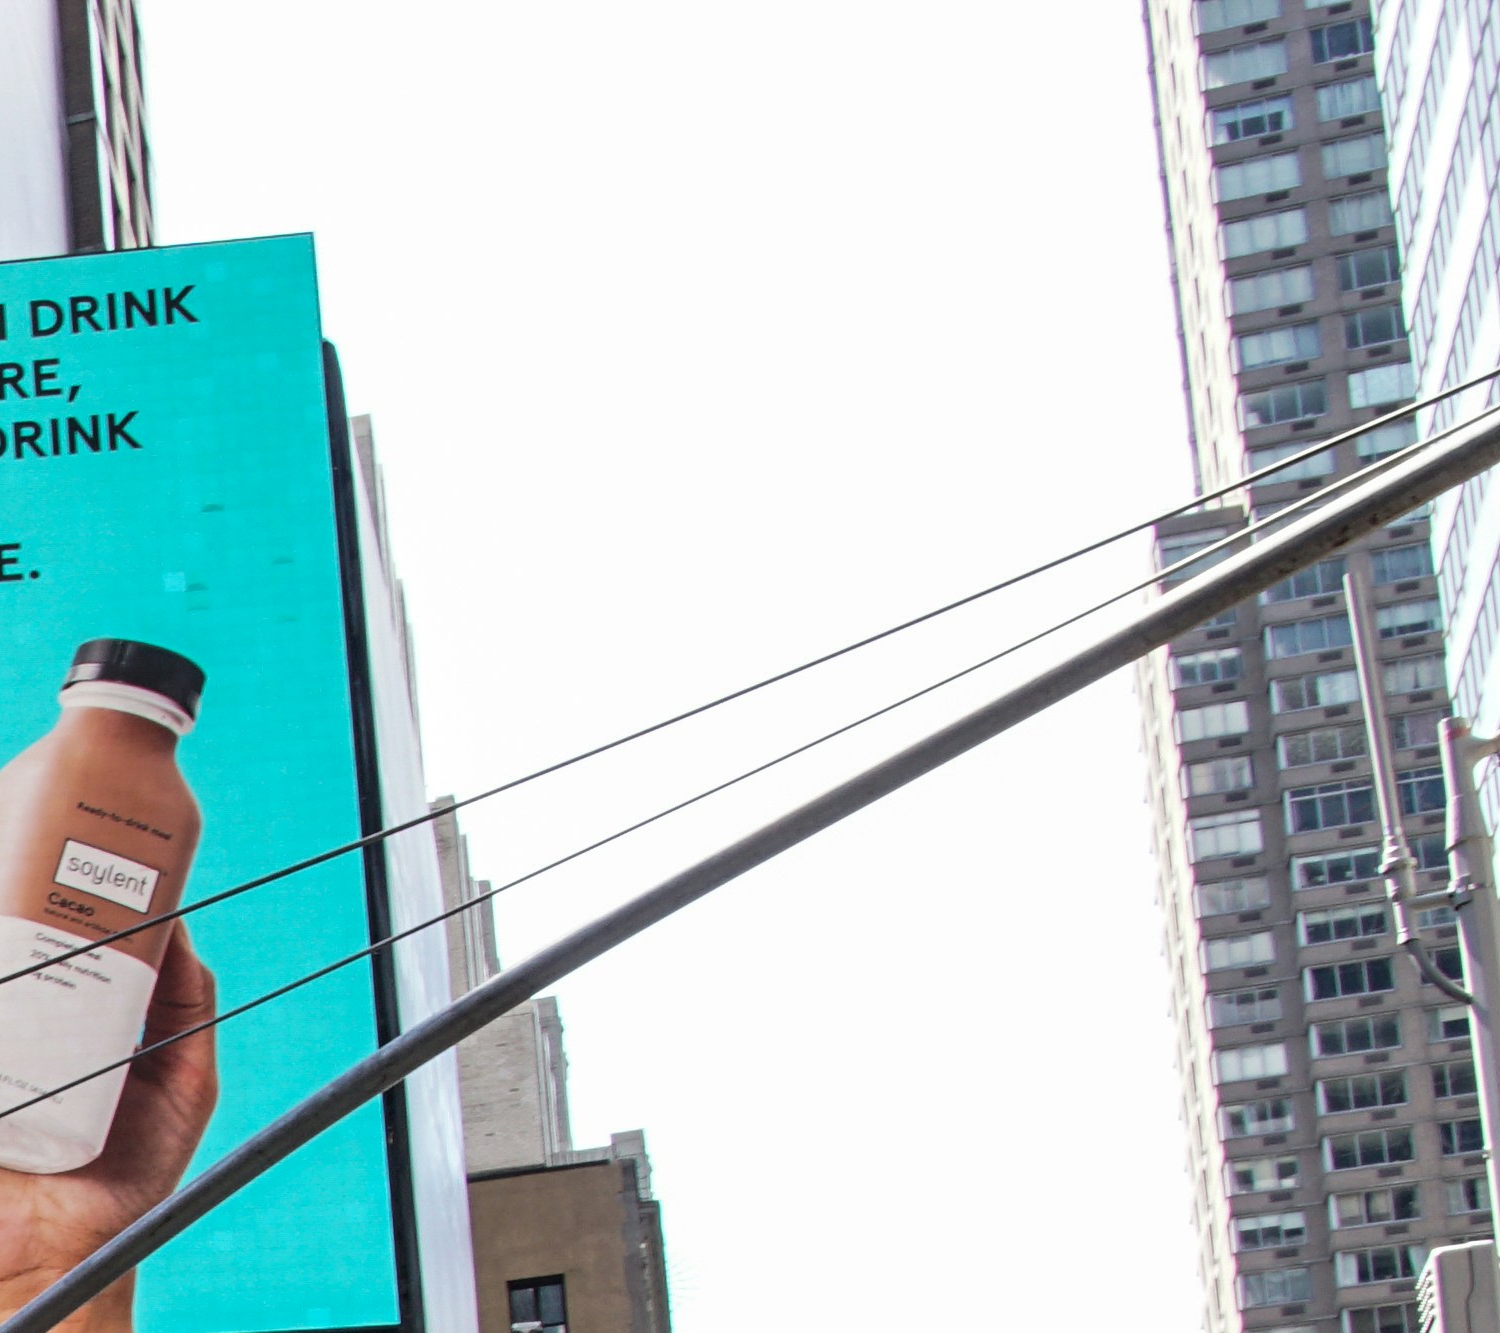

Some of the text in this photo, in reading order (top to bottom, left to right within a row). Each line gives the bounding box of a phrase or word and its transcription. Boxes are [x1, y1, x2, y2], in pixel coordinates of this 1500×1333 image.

[29, 284, 199, 337] DRINK
[67, 857, 148, 897] soylent
[48, 892, 95, 917] Cacao
